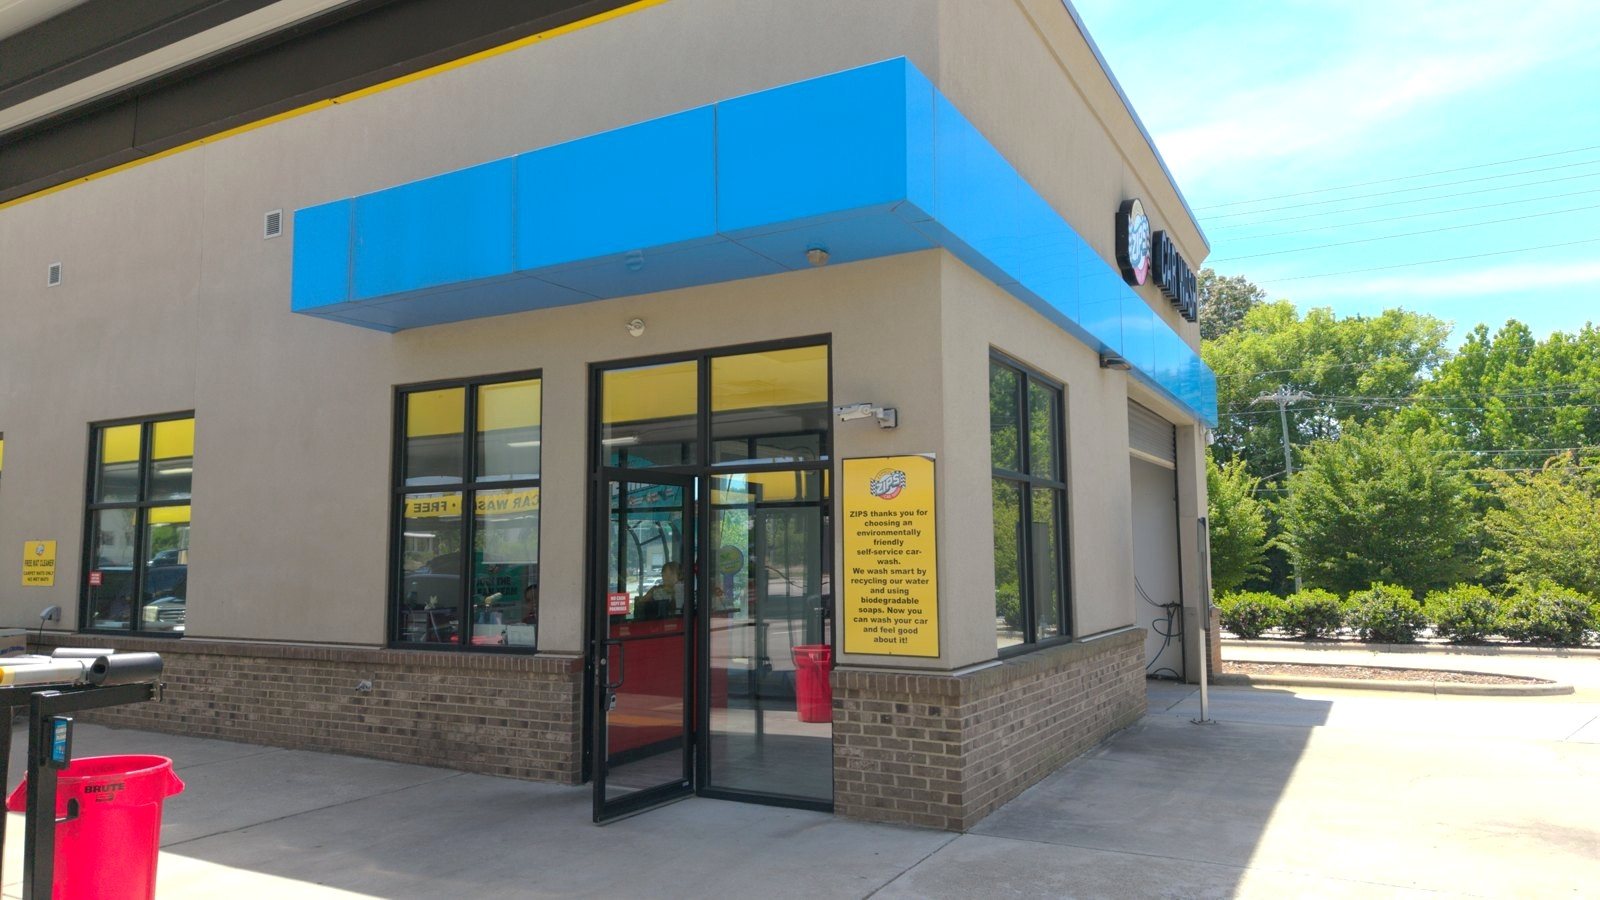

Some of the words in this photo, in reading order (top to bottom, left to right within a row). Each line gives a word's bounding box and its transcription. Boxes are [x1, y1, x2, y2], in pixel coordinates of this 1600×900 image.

[876, 472, 900, 495] ZIPS
[917, 568, 927, 576] by
[84, 782, 125, 793] BRUTE
